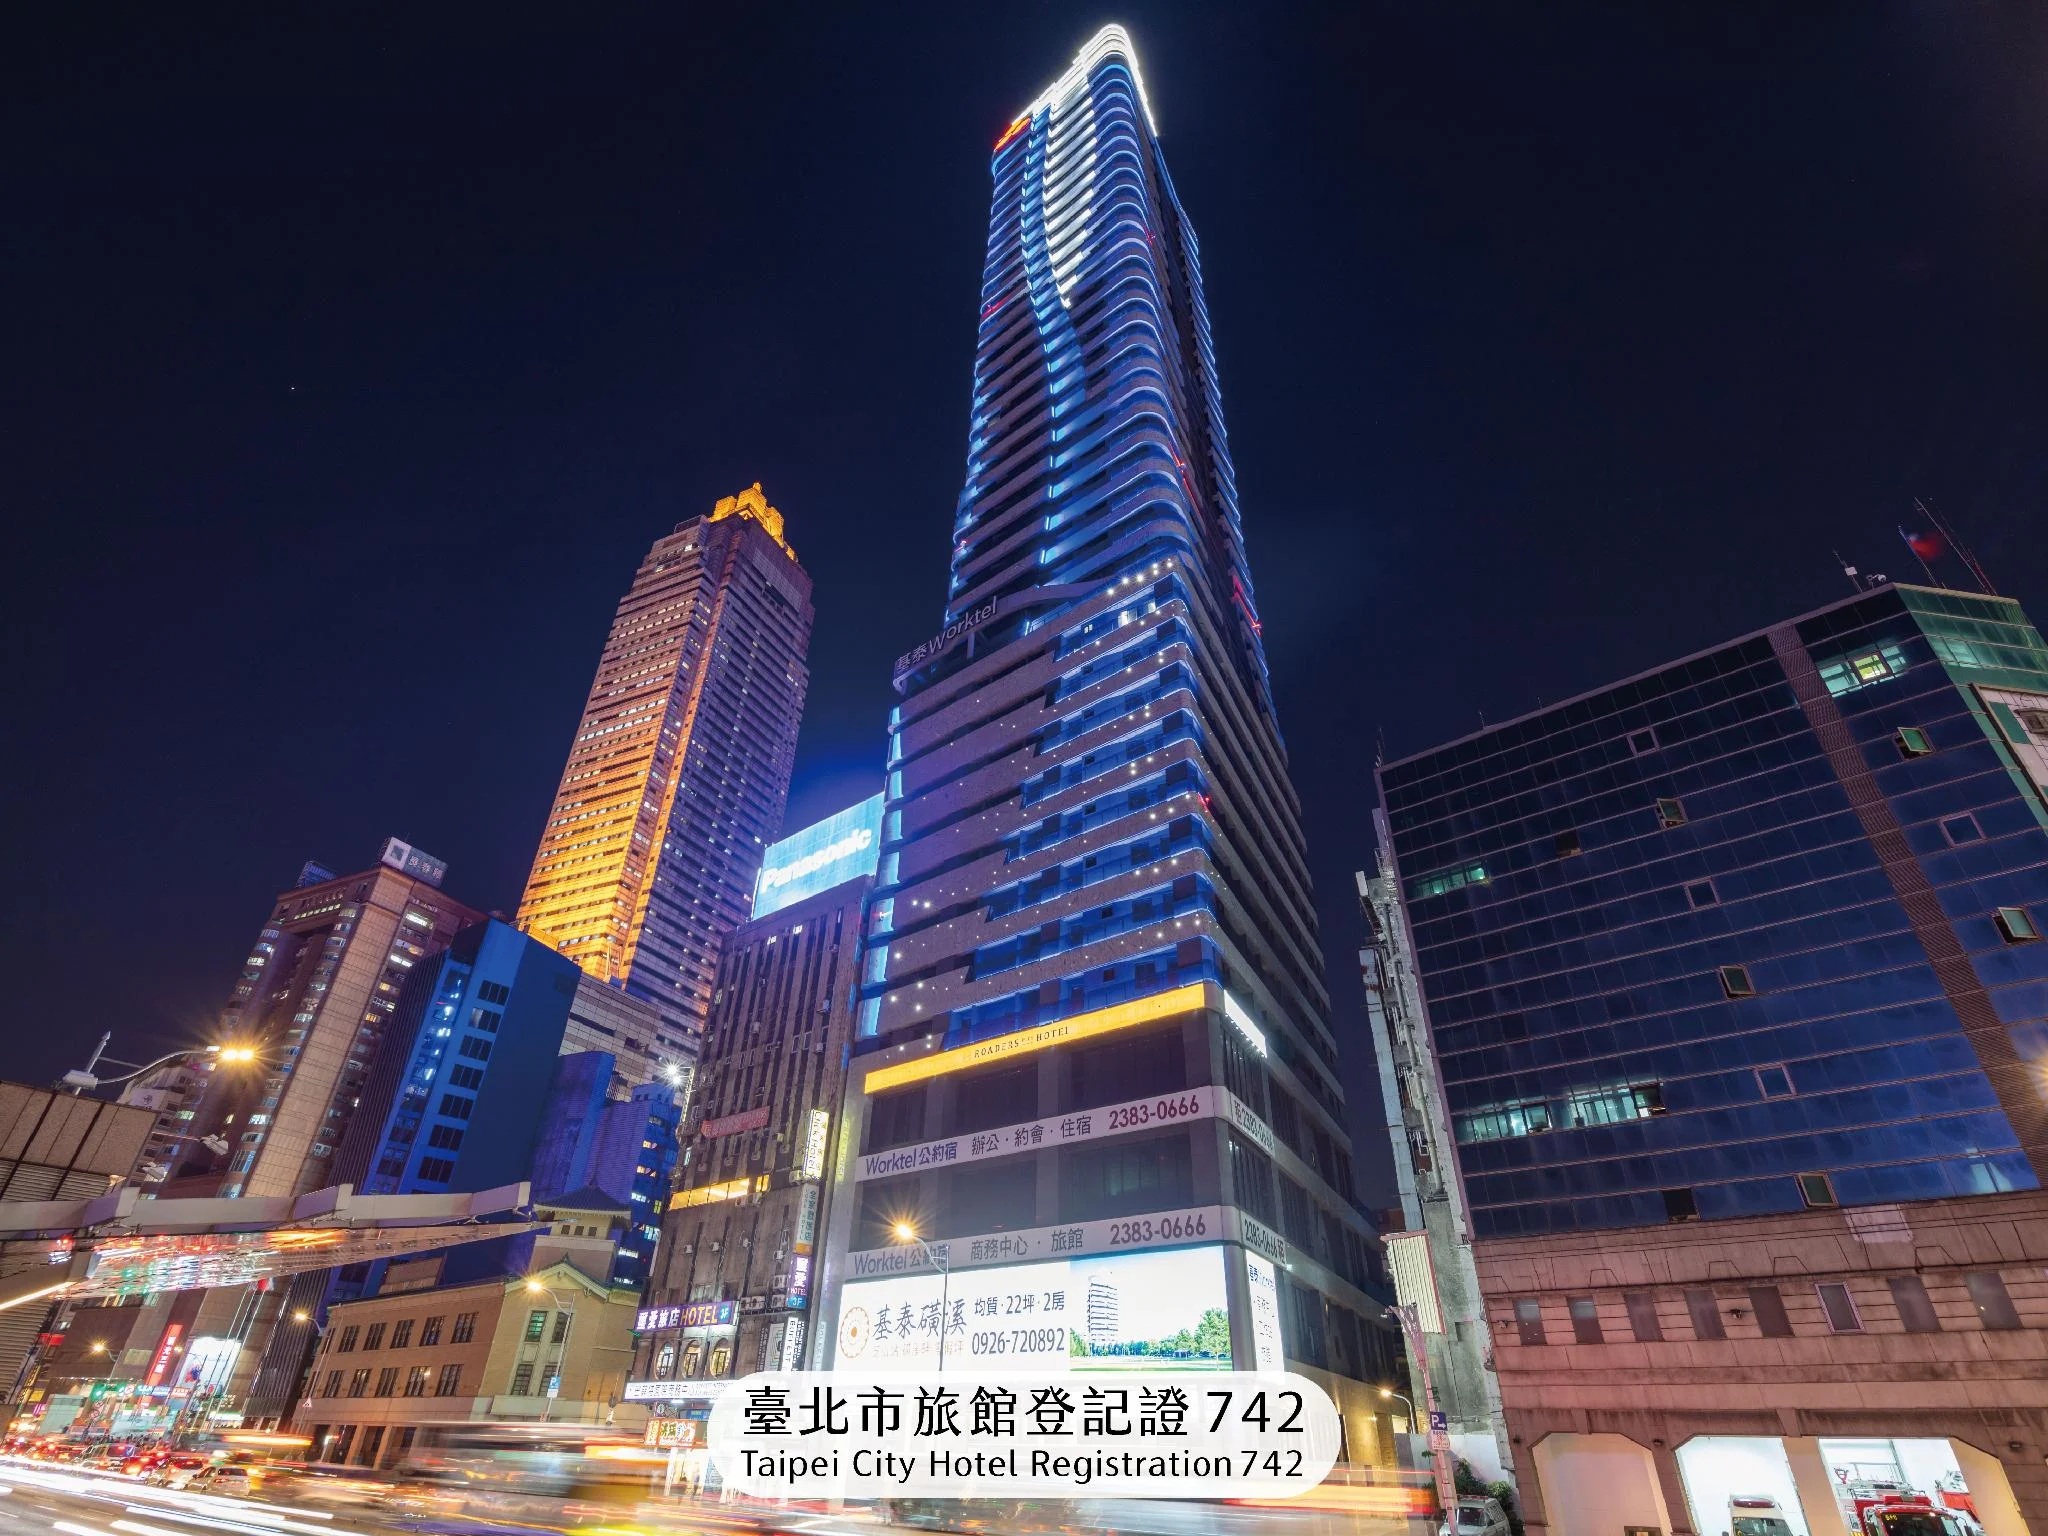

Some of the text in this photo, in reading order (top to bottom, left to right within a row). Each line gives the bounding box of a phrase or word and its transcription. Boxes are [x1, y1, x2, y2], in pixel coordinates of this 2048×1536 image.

[974, 1038, 1019, 1059] ROADERS
[1108, 1095, 1200, 1131] 2383-0666
[1110, 1214, 1207, 1246] 2383-0666
[680, 1305, 718, 1326] HOTEL
[972, 1328, 1065, 1356] 0926-720892
[1431, 1415, 1440, 1427] P
